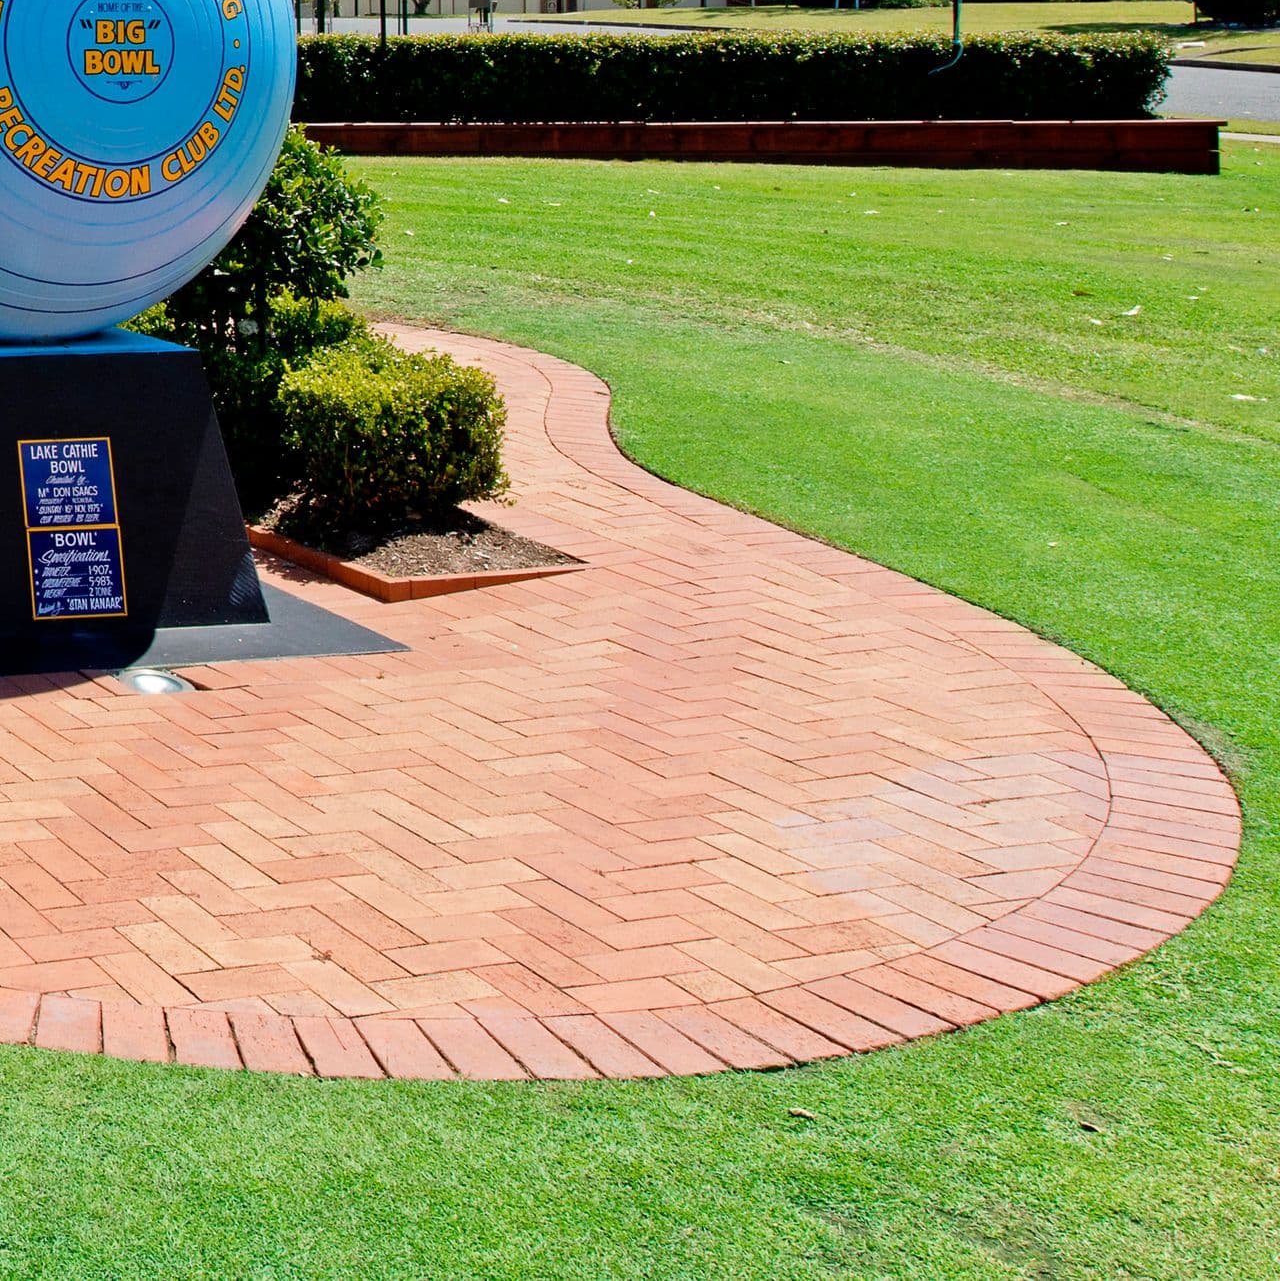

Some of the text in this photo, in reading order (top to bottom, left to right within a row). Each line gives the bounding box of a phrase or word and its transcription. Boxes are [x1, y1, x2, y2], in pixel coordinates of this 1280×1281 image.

[97, 2, 119, 13] HOME
[120, 2, 130, 13] OF
[84, 49, 161, 75] BOWL
[160, 121, 220, 182] CLUB
[30, 443, 99, 460] LAKE CATHIE
[50, 460, 86, 474] BOWL
[53, 487, 71, 498] DON
[72, 485, 98, 497] ISAACS
[38, 549, 111, 566] Specifications
[88, 587, 95, 597] 2
